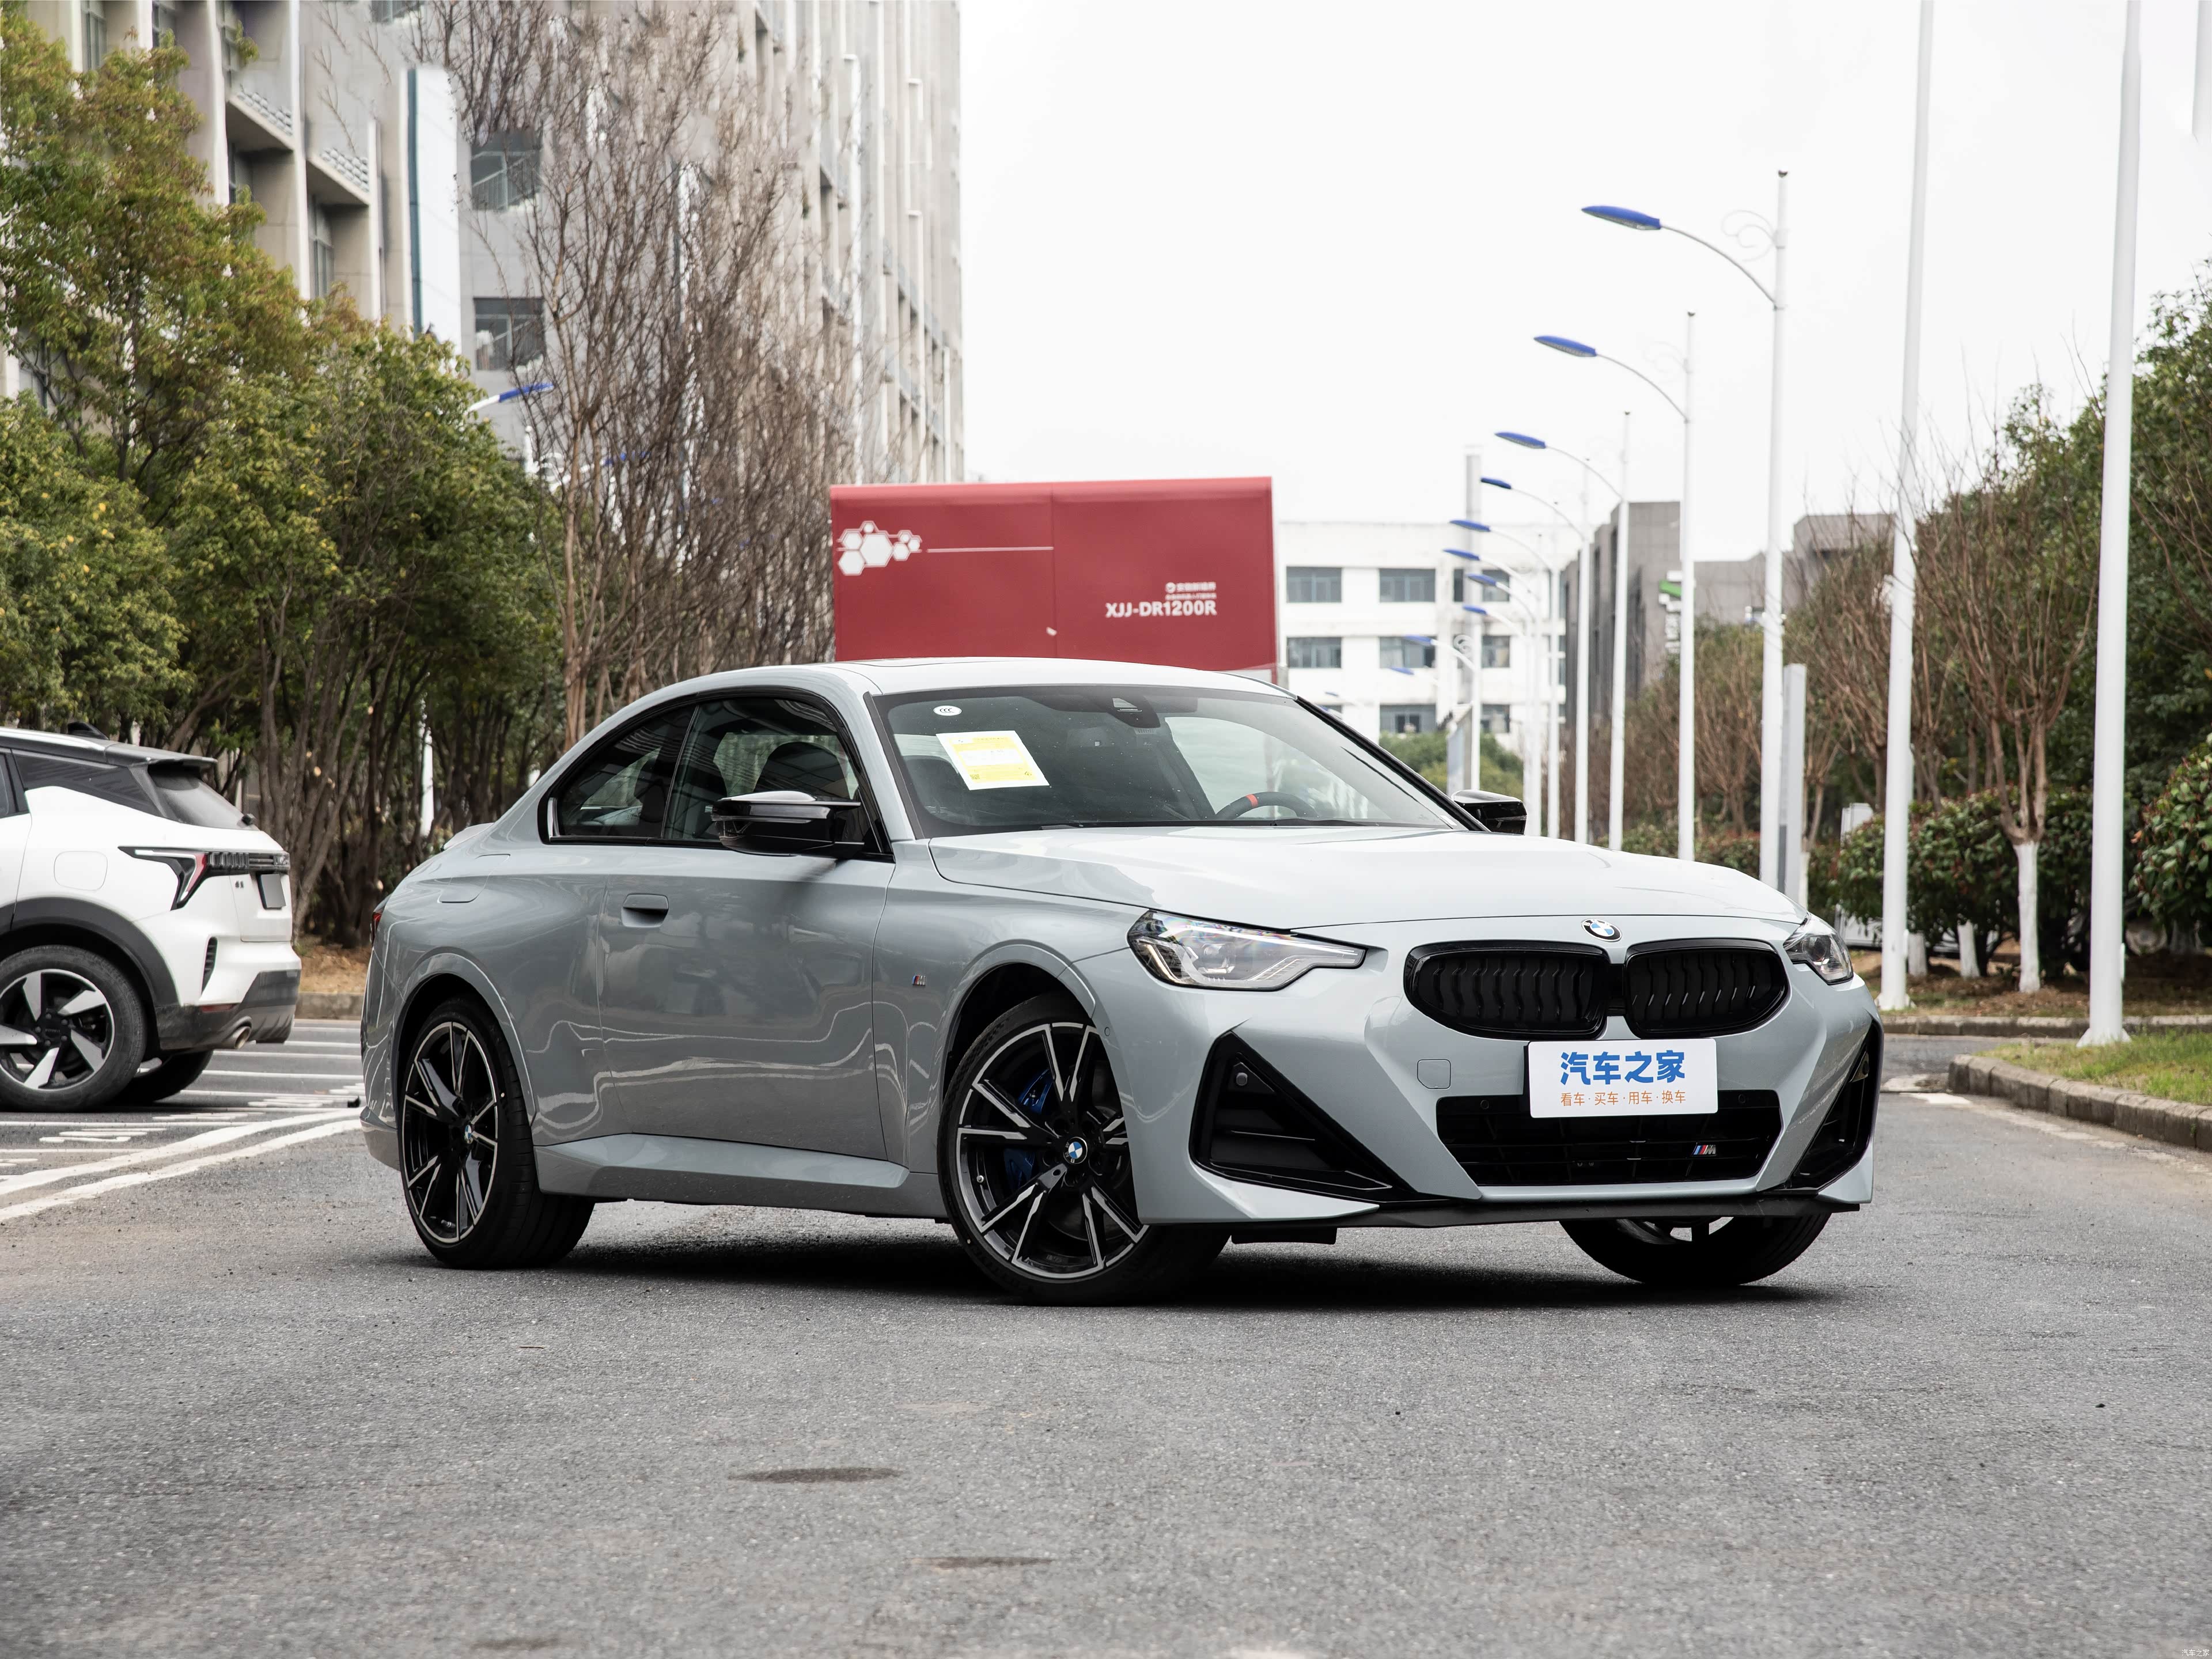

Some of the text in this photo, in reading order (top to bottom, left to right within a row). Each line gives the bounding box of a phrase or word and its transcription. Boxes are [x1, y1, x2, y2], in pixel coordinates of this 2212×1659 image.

[1105, 600, 1217, 618] XJJ-DR1200R
[1560, 1050, 1685, 1085] 汽车之家
